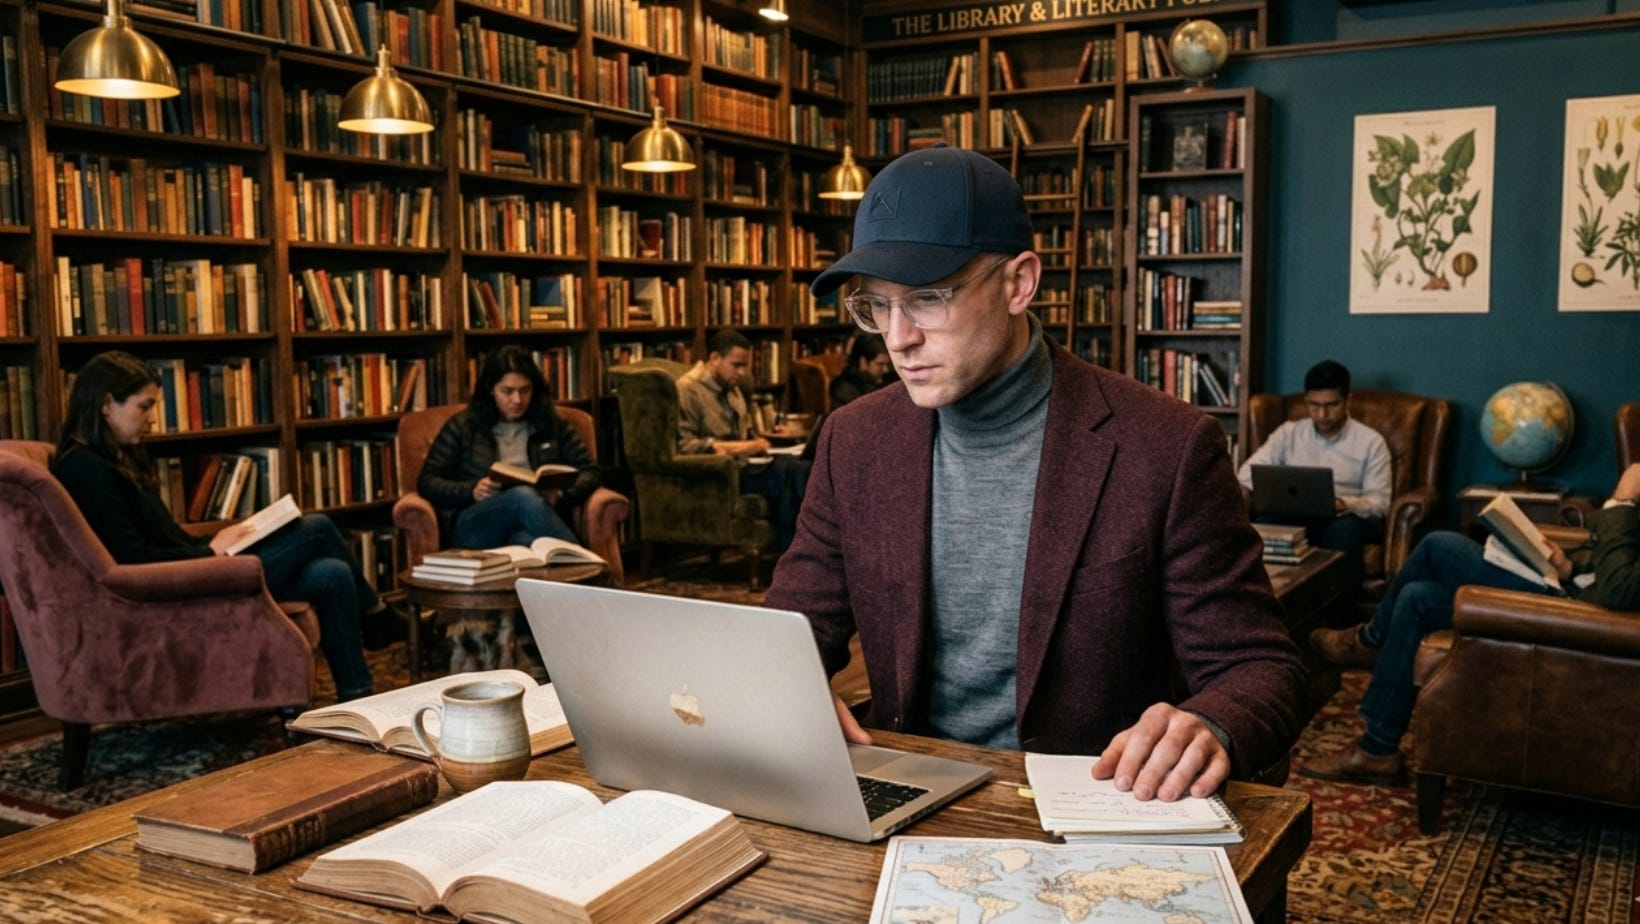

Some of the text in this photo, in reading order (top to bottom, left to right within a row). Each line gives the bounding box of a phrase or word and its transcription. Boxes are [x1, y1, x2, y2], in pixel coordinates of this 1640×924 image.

[892, 14, 932, 36] THE
[938, 3, 1026, 31] LIBRARY
[1029, 1, 1047, 22] &
